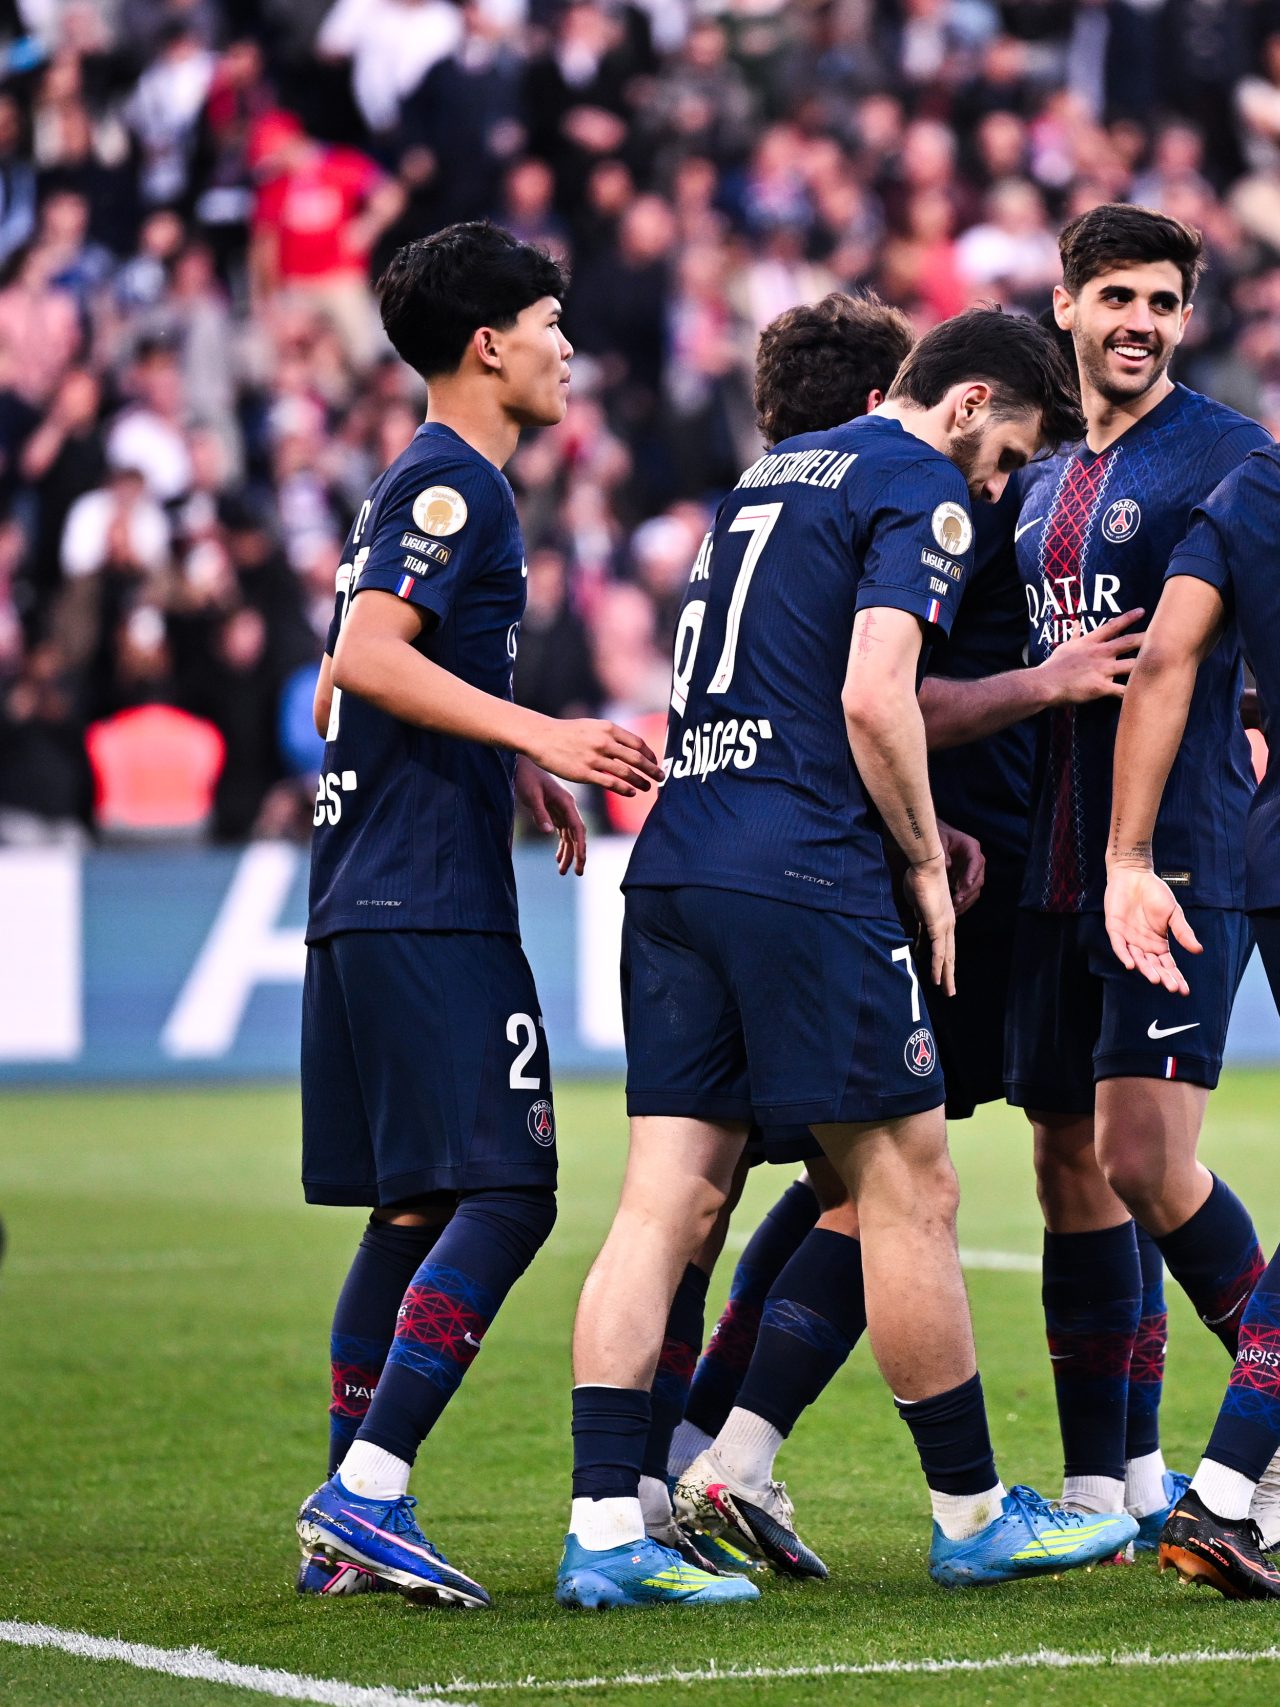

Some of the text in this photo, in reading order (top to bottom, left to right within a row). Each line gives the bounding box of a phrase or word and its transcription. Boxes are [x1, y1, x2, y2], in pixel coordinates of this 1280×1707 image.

[733, 449, 859, 491] ARATSKHELIA
[1112, 501, 1137, 513] PARIS
[402, 535, 429, 553] LIGUE
[922, 551, 946, 571] LIGUE
[706, 502, 783, 694] 7
[891, 944, 921, 1022] 7
[506, 1012, 553, 1094] 2
[909, 1030, 930, 1045] PARIS
